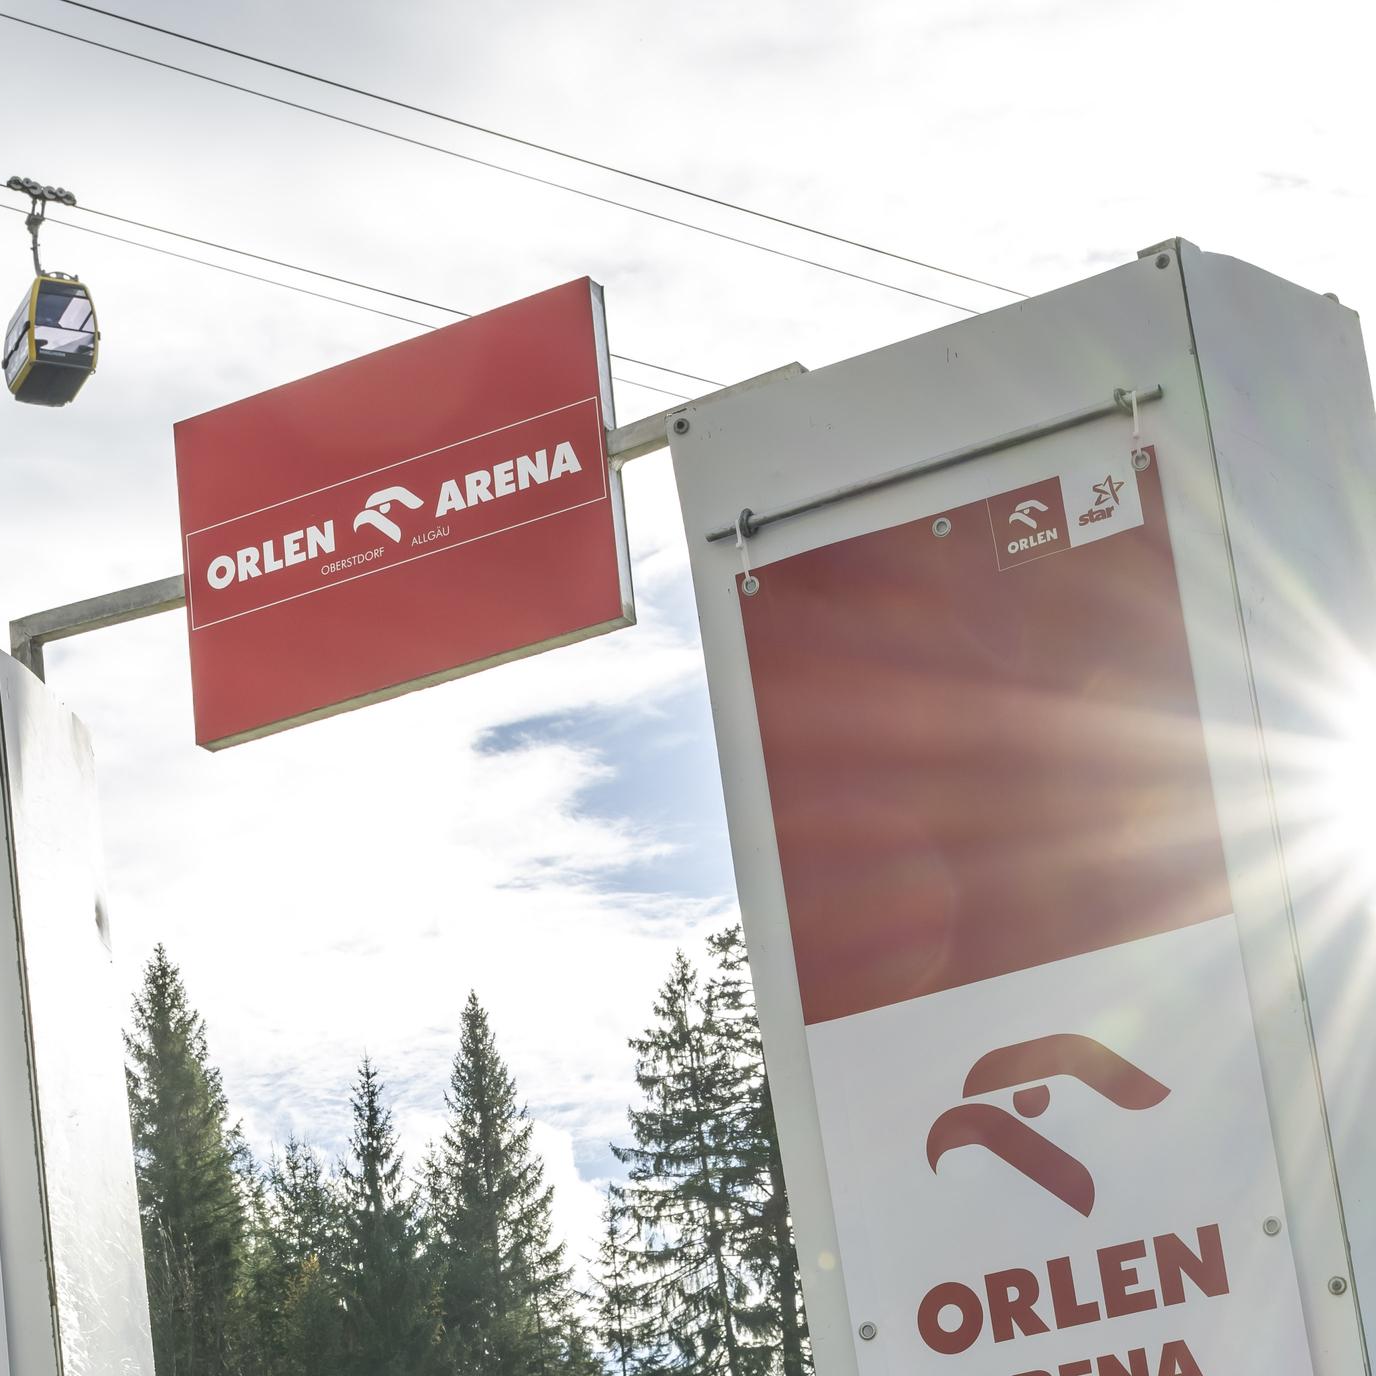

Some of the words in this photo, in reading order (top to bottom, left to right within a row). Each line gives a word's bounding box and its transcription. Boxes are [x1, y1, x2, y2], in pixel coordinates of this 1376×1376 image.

[207, 520, 335, 589] ORLEN
[435, 441, 582, 517] ARENA
[1079, 505, 1114, 526] star
[321, 546, 384, 576] OBERSTDORF
[411, 525, 450, 547] ALLGÄU
[1008, 528, 1058, 554] ORLEN
[917, 1223, 1230, 1355] ORLEN
